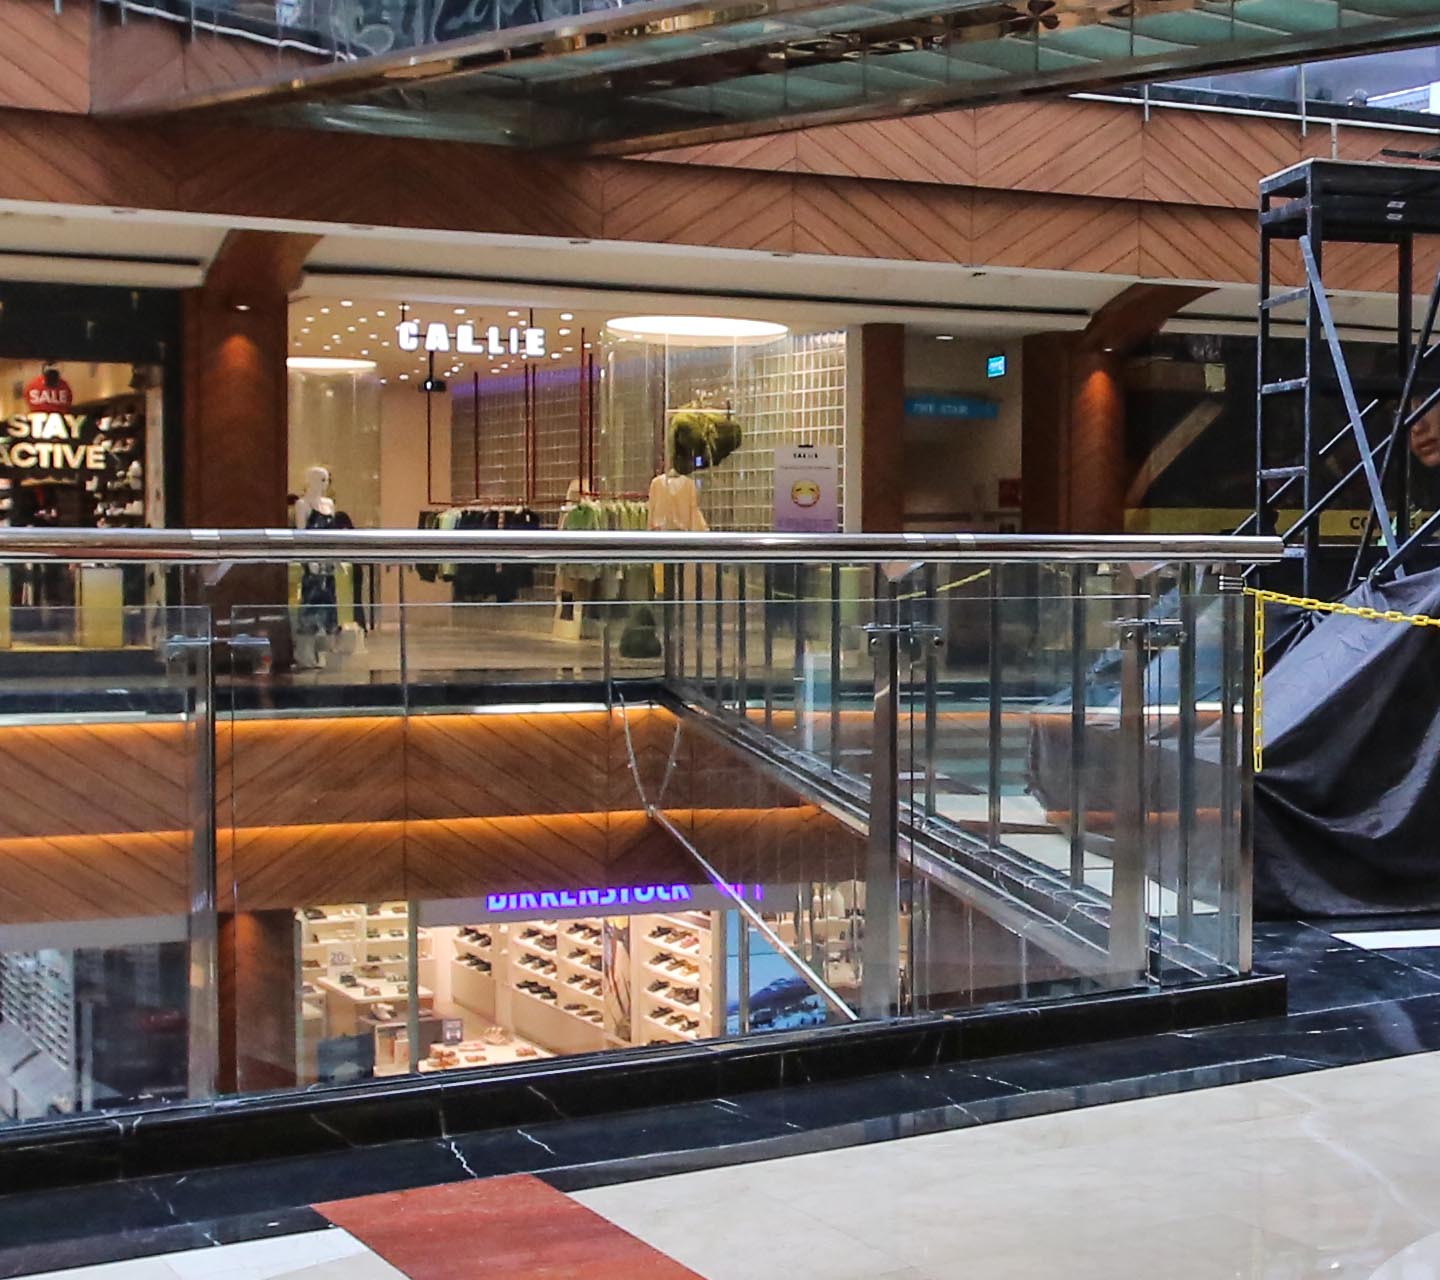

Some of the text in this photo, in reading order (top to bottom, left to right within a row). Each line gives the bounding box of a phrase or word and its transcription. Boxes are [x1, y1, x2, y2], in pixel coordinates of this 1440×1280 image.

[398, 321, 546, 357] CALLIE
[29, 389, 67, 405] SALE
[7, 412, 87, 440] STAY
